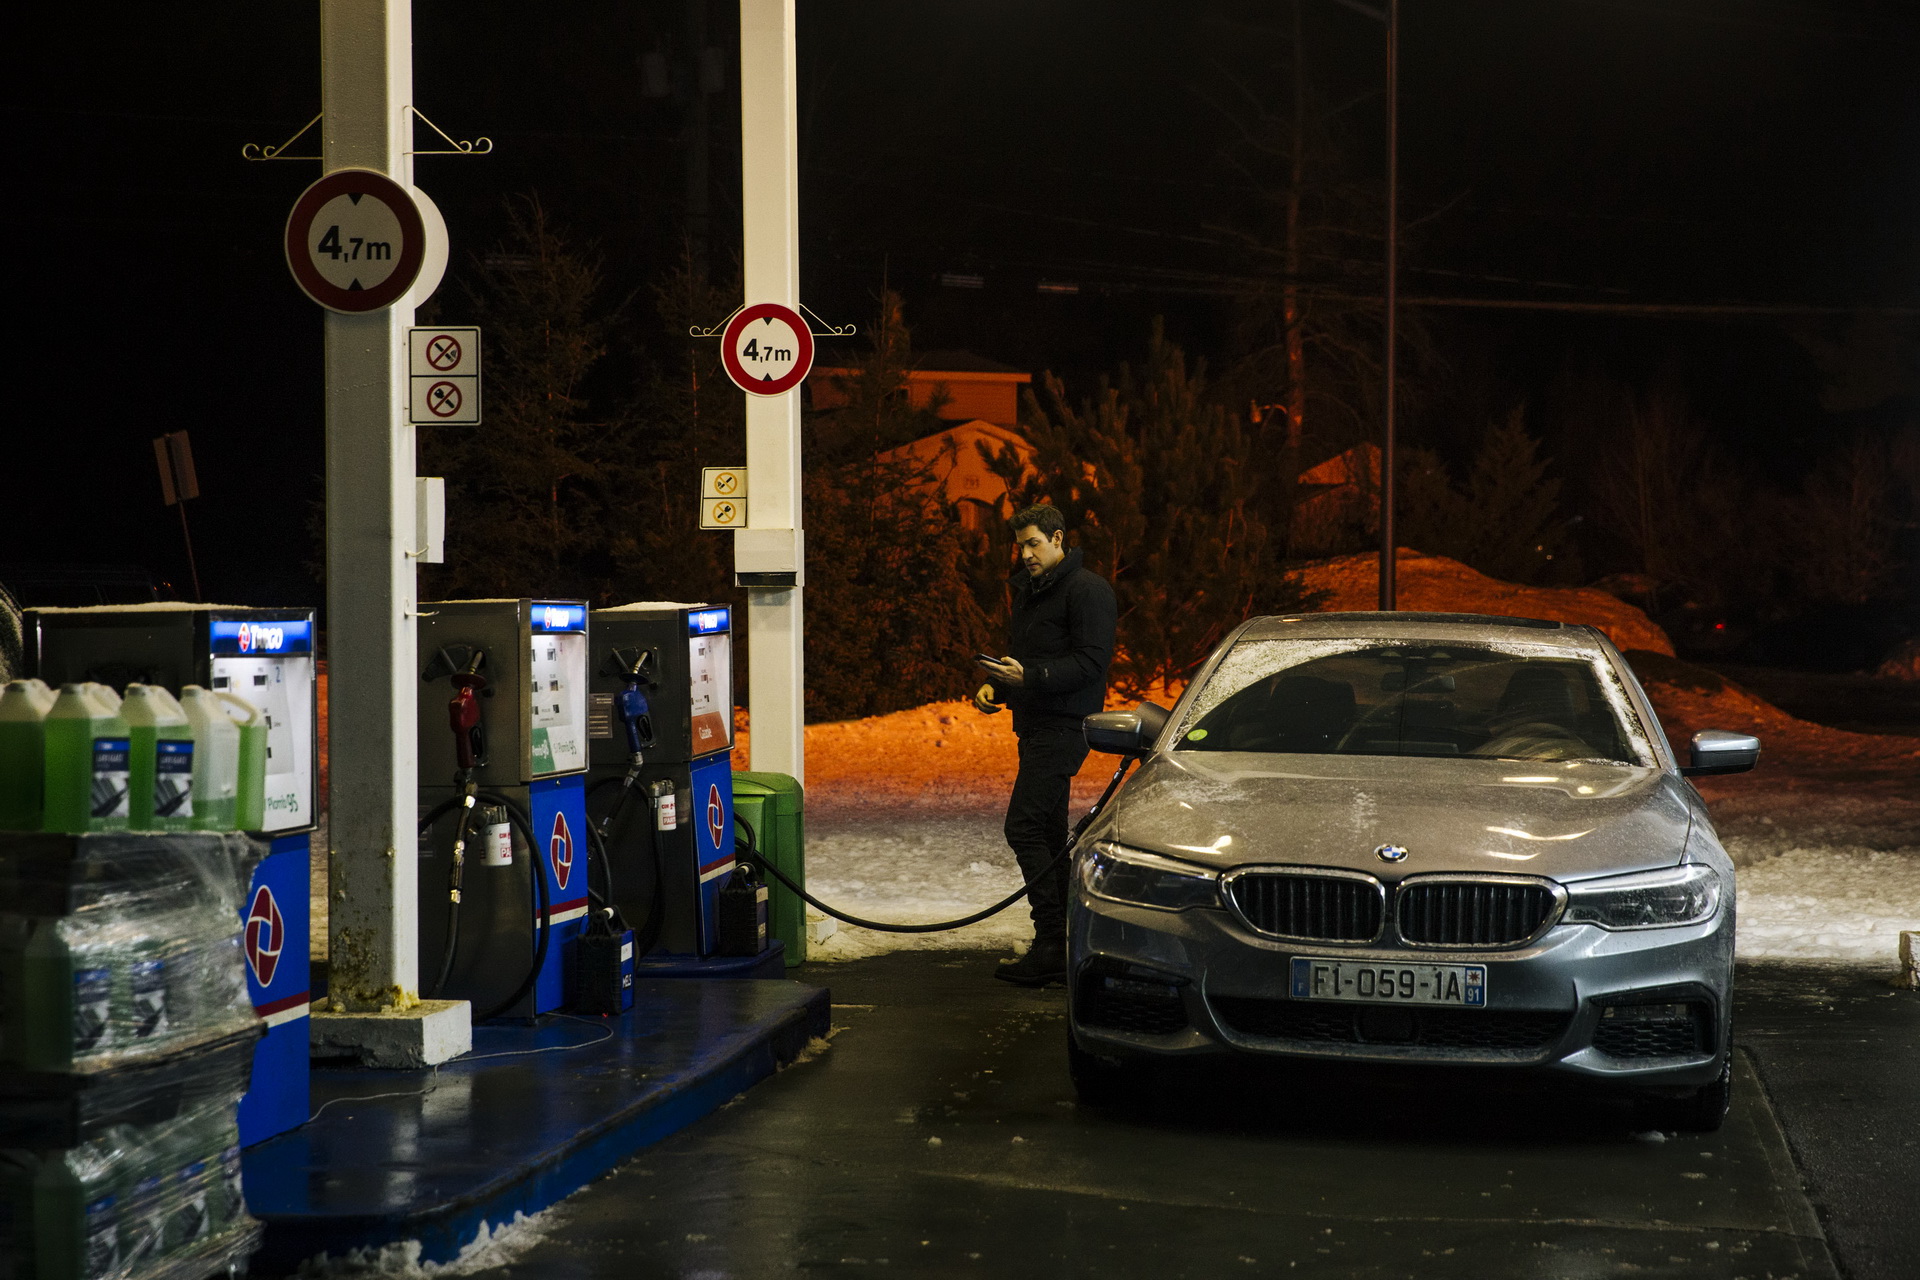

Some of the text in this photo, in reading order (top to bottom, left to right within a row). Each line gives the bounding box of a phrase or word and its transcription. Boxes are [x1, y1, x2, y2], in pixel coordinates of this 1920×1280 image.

[318, 225, 391, 263] 4,7m
[743, 338, 792, 363] 4,7m
[1467, 987, 1480, 1002] 91
